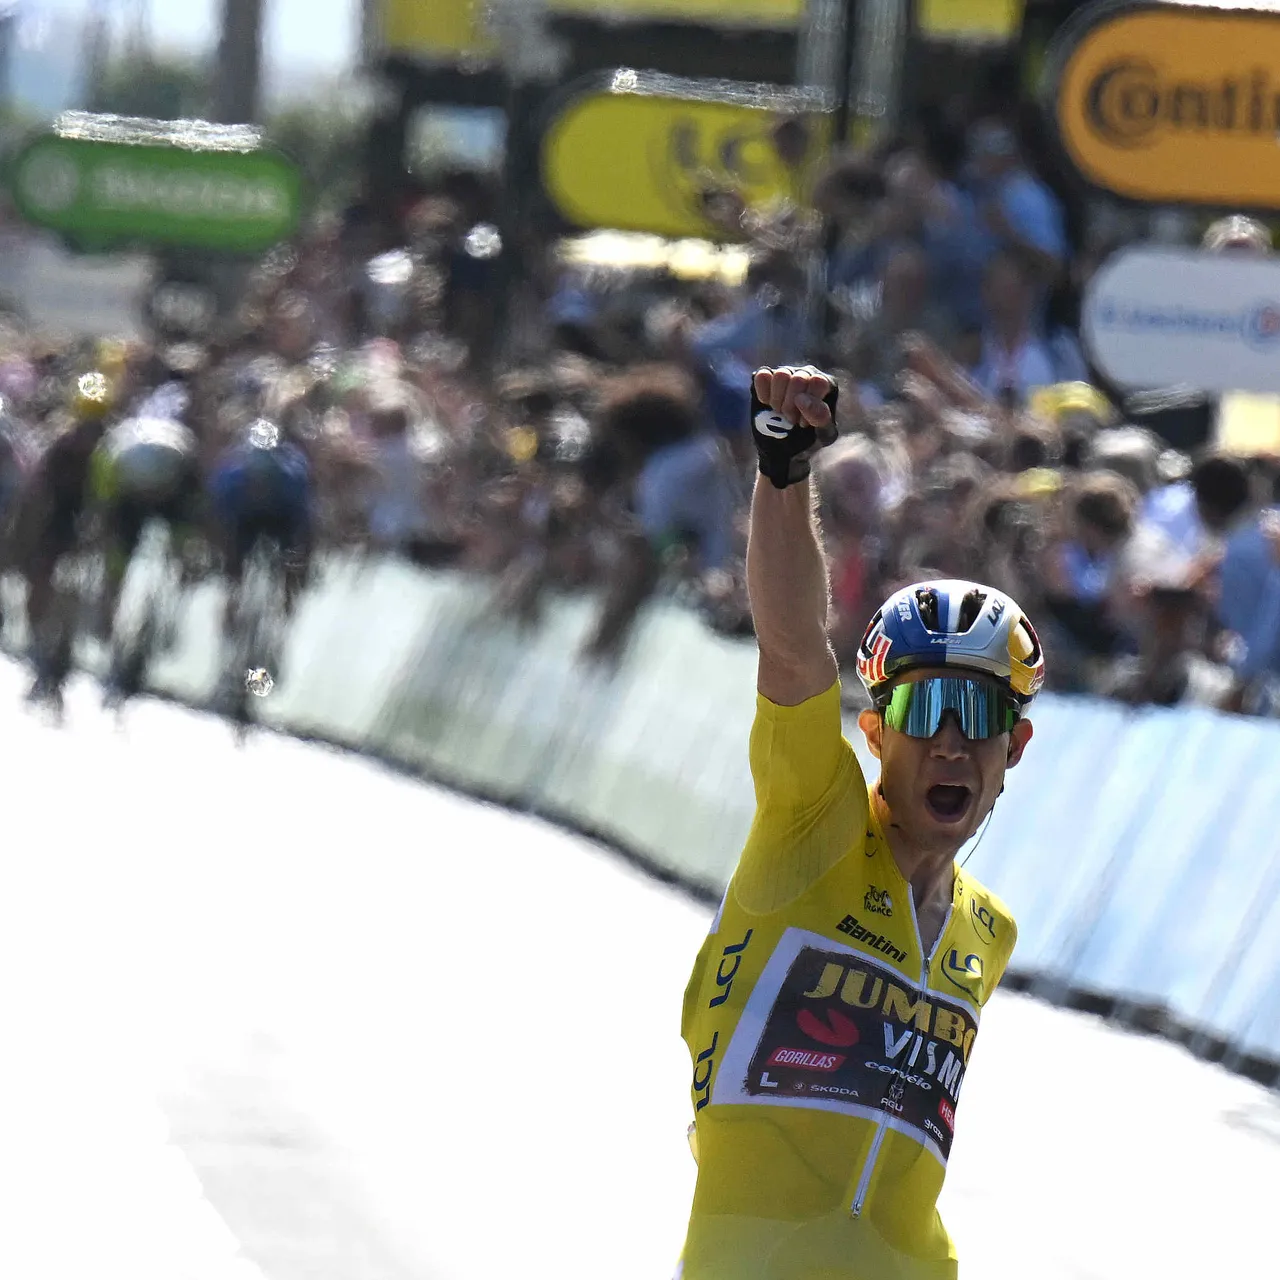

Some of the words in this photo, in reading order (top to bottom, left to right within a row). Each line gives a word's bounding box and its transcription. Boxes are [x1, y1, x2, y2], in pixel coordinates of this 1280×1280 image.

[835, 914, 908, 963] Santini
[972, 898, 996, 938] LCL
[709, 928, 754, 1008] LCL
[694, 1031, 719, 1112] LCL
[774, 1049, 836, 1069] GORILLAS
[883, 1021, 964, 1103] VISM
